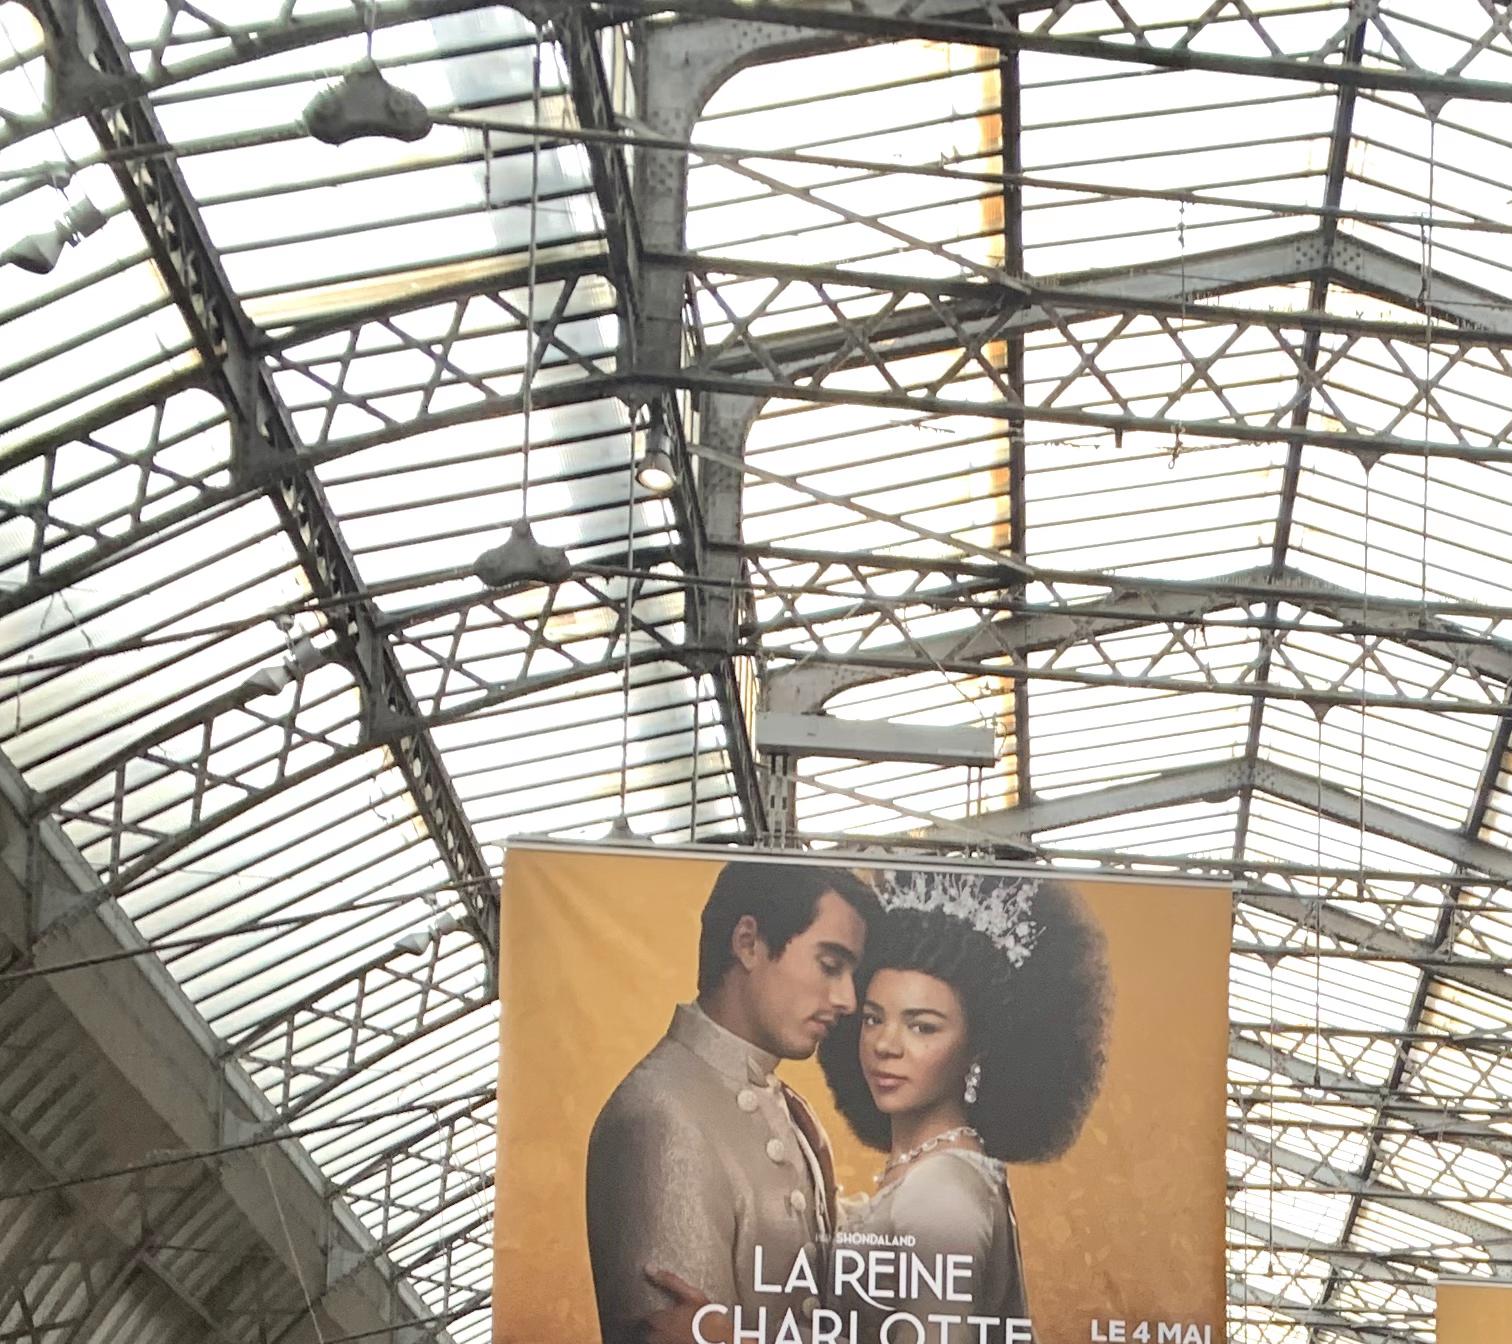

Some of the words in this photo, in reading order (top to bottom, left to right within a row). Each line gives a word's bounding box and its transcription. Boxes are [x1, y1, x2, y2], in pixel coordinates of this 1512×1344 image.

[836, 1232, 916, 1247] SHONDALAND
[754, 1245, 818, 1296] LA
[834, 1247, 973, 1311] REINE
[1091, 1320, 1127, 1344] LE
[1132, 1323, 1149, 1344] 4
